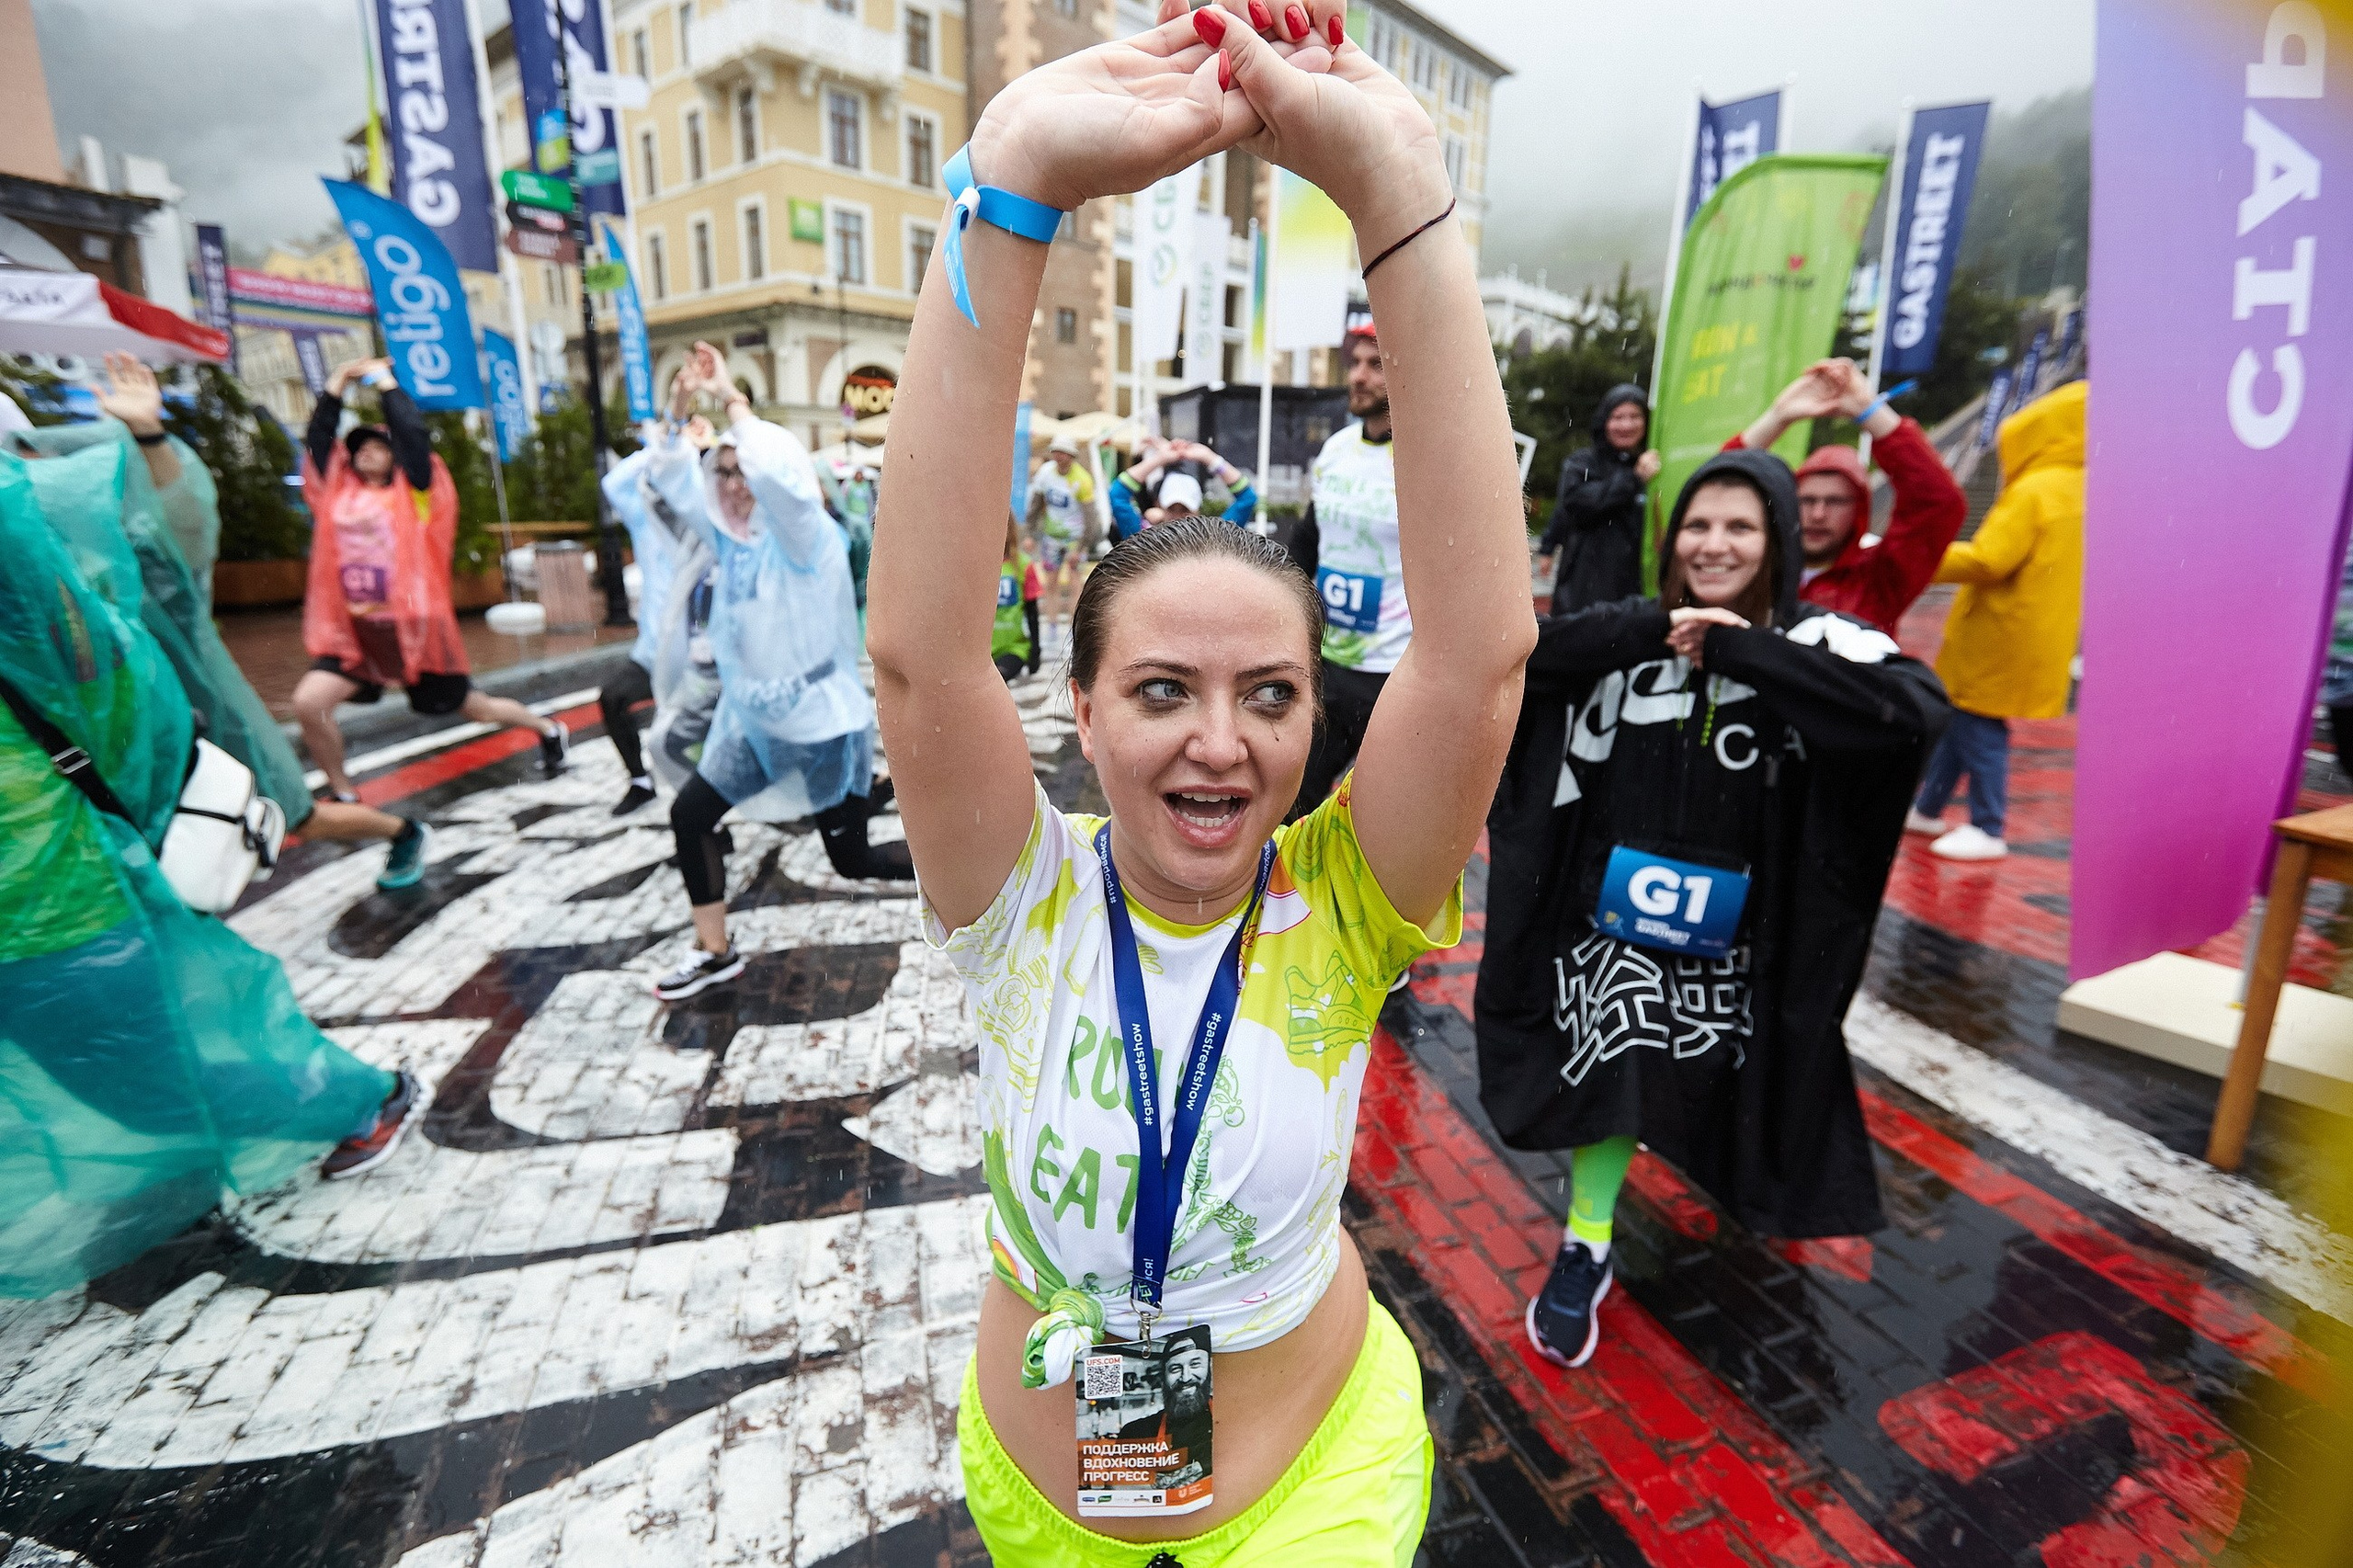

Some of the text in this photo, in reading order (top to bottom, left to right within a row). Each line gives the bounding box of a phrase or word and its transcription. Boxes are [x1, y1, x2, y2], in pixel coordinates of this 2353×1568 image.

[374, 233, 457, 397] religo
[1324, 573, 1365, 611] G1
[1099, 833, 1117, 904] #прорвемся!
[1628, 865, 1713, 924] G1
[1131, 1023, 1154, 1126] #gastreetshow
[1188, 1012, 1223, 1111] #gastreetshow
[1086, 1358, 1120, 1366] UFS.COM
[1083, 1441, 1169, 1456] ПОДДЕРЖКА
[1083, 1453, 1180, 1470] ВДОХНОВЕНИЕ
[1083, 1471, 1151, 1483] ПРОГРЕСС
